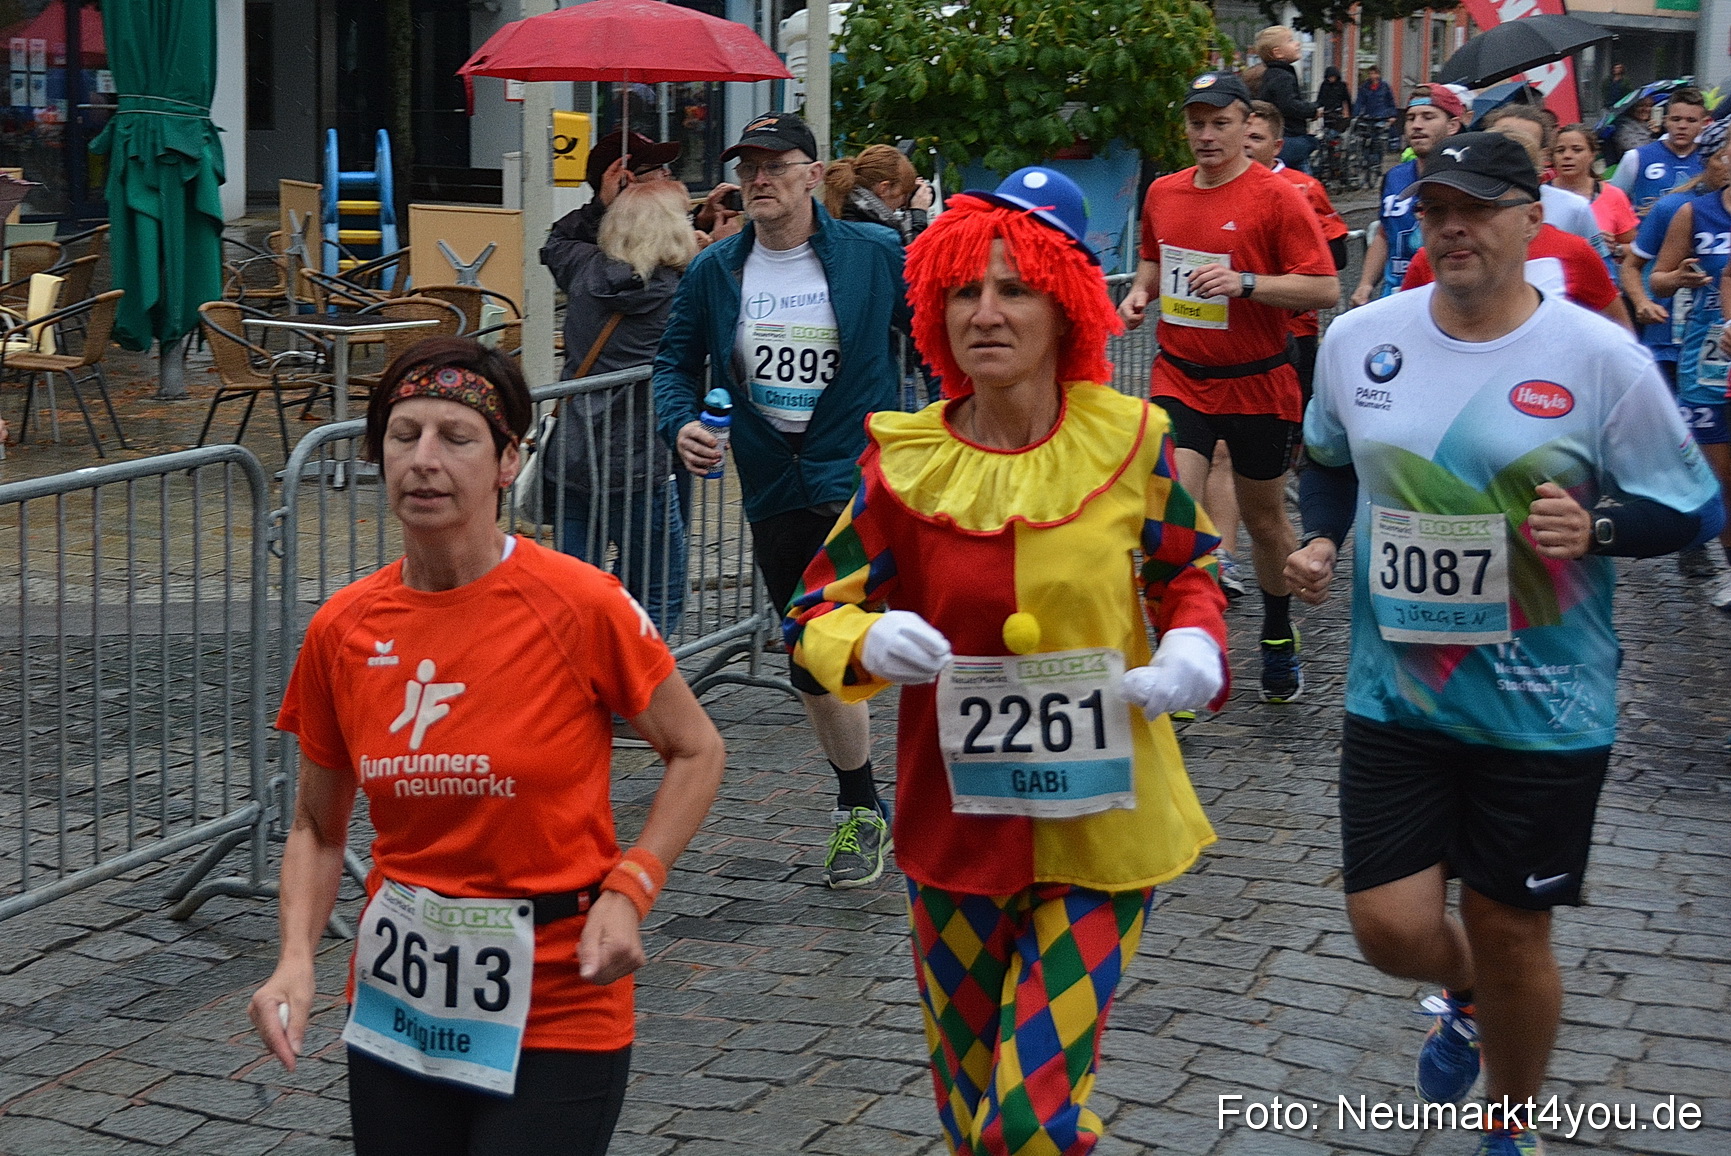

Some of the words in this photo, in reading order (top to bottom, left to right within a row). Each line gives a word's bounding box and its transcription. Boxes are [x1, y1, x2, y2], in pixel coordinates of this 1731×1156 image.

[1644, 162, 1666, 180] 6
[1694, 231, 1731, 255] 22
[755, 344, 839, 385] 2893
[1355, 386, 1393, 403] PARTL
[1516, 386, 1567, 410] Hervis
[1419, 518, 1491, 537] BOCK
[1380, 541, 1492, 597] 3087
[1394, 604, 1487, 626] JÜRGEN
[1018, 653, 1109, 680] BOCK
[960, 689, 1106, 754] 2261
[360, 753, 491, 784] funrunners
[1011, 769, 1069, 793] GABi
[394, 773, 517, 798] neumarkt
[422, 898, 515, 930] BOCK
[371, 916, 511, 1012] 2613
[392, 1007, 472, 1053] Brigitte
